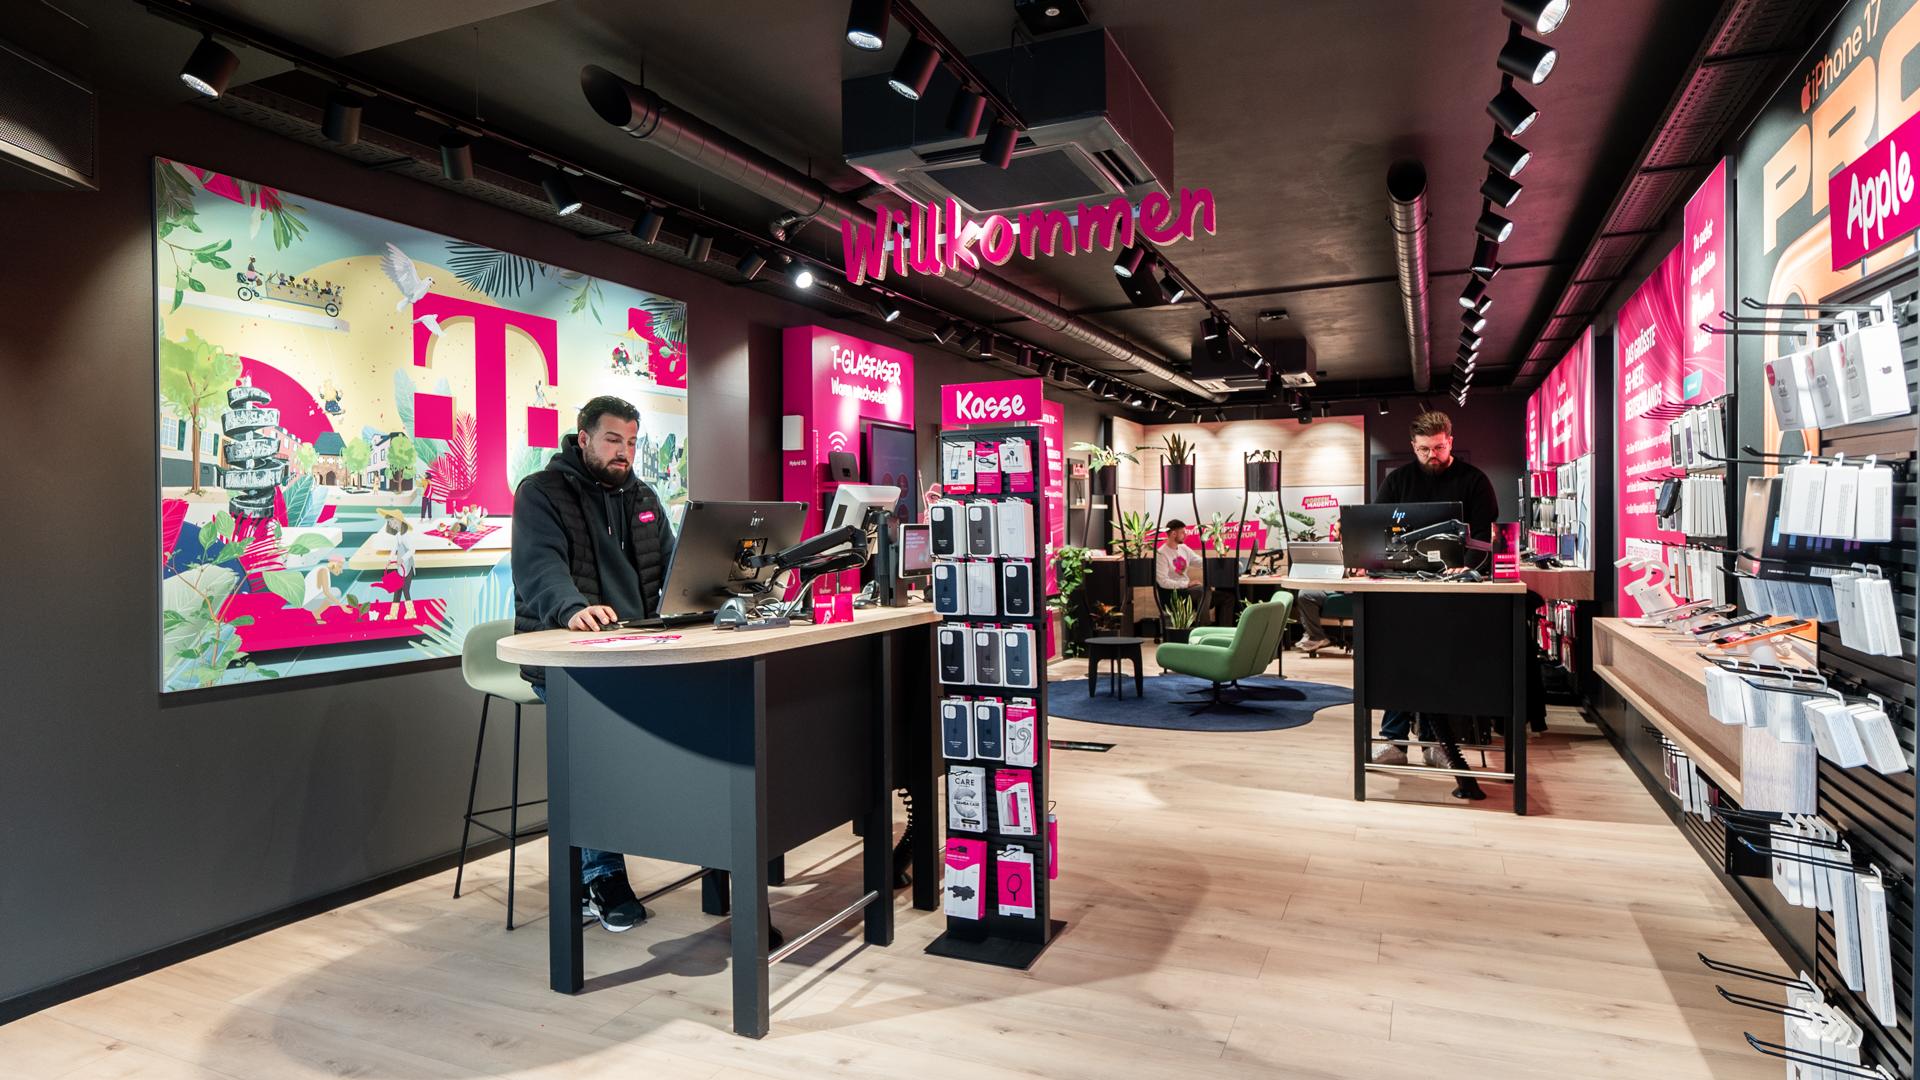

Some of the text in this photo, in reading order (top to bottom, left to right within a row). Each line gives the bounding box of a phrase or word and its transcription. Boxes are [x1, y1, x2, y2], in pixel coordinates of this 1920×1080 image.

[1811, 0, 1882, 103] iPhone 17
[1846, 140, 1915, 250] Apple
[841, 186, 1217, 285] Willkommen
[831, 346, 901, 384] T-GLASFASER
[956, 390, 1026, 420] Kasse
[955, 778, 975, 786] CARE
